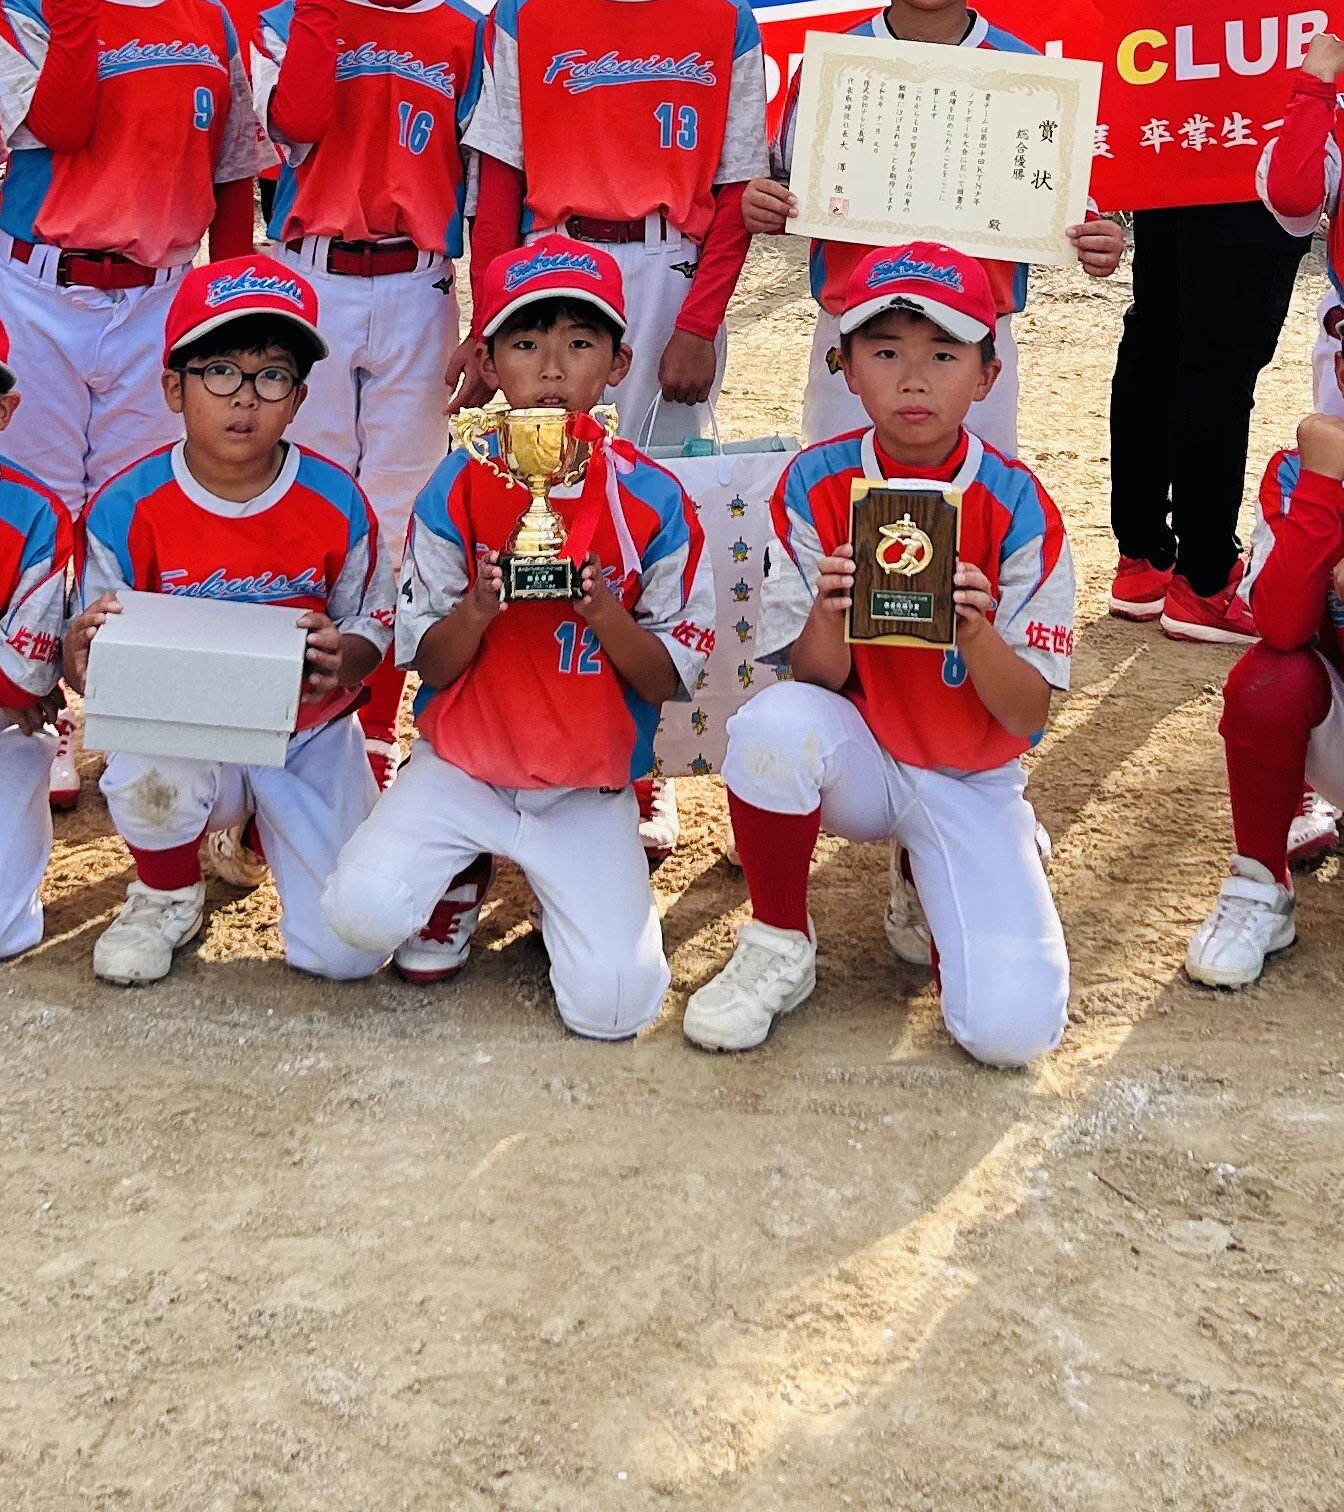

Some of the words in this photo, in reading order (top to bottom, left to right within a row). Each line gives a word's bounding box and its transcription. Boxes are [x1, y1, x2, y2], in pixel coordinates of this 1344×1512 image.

[95, 39, 229, 81] ukuishi
[544, 49, 717, 94] Fukuishi
[1116, 9, 1330, 85] CLUB
[193, 87, 215, 131] 9
[398, 101, 434, 156] 16
[654, 102, 699, 152] 13
[554, 621, 602, 675] 12
